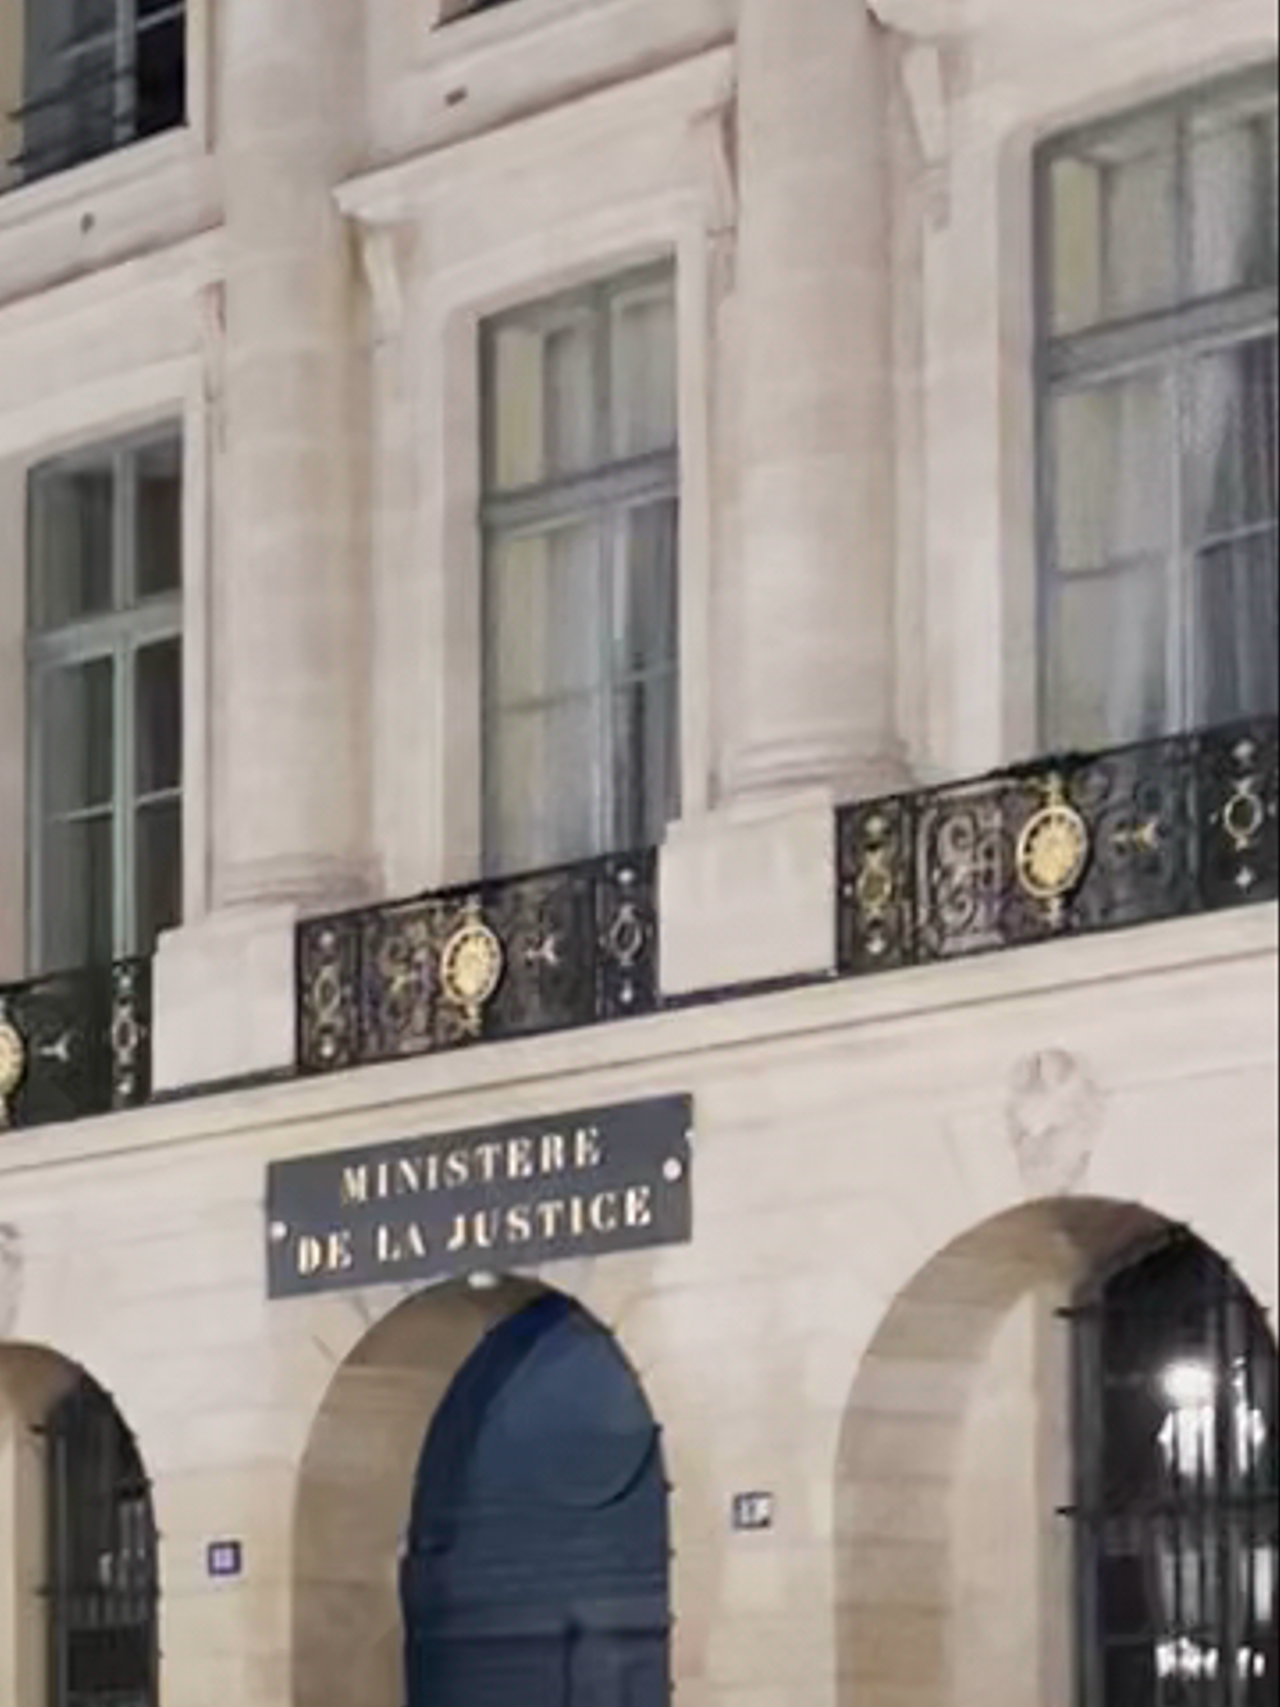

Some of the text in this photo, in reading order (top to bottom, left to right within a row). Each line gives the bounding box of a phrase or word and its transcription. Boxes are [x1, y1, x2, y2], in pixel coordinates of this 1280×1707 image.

[297, 1185, 652, 1275] DE LA JUSTICE
